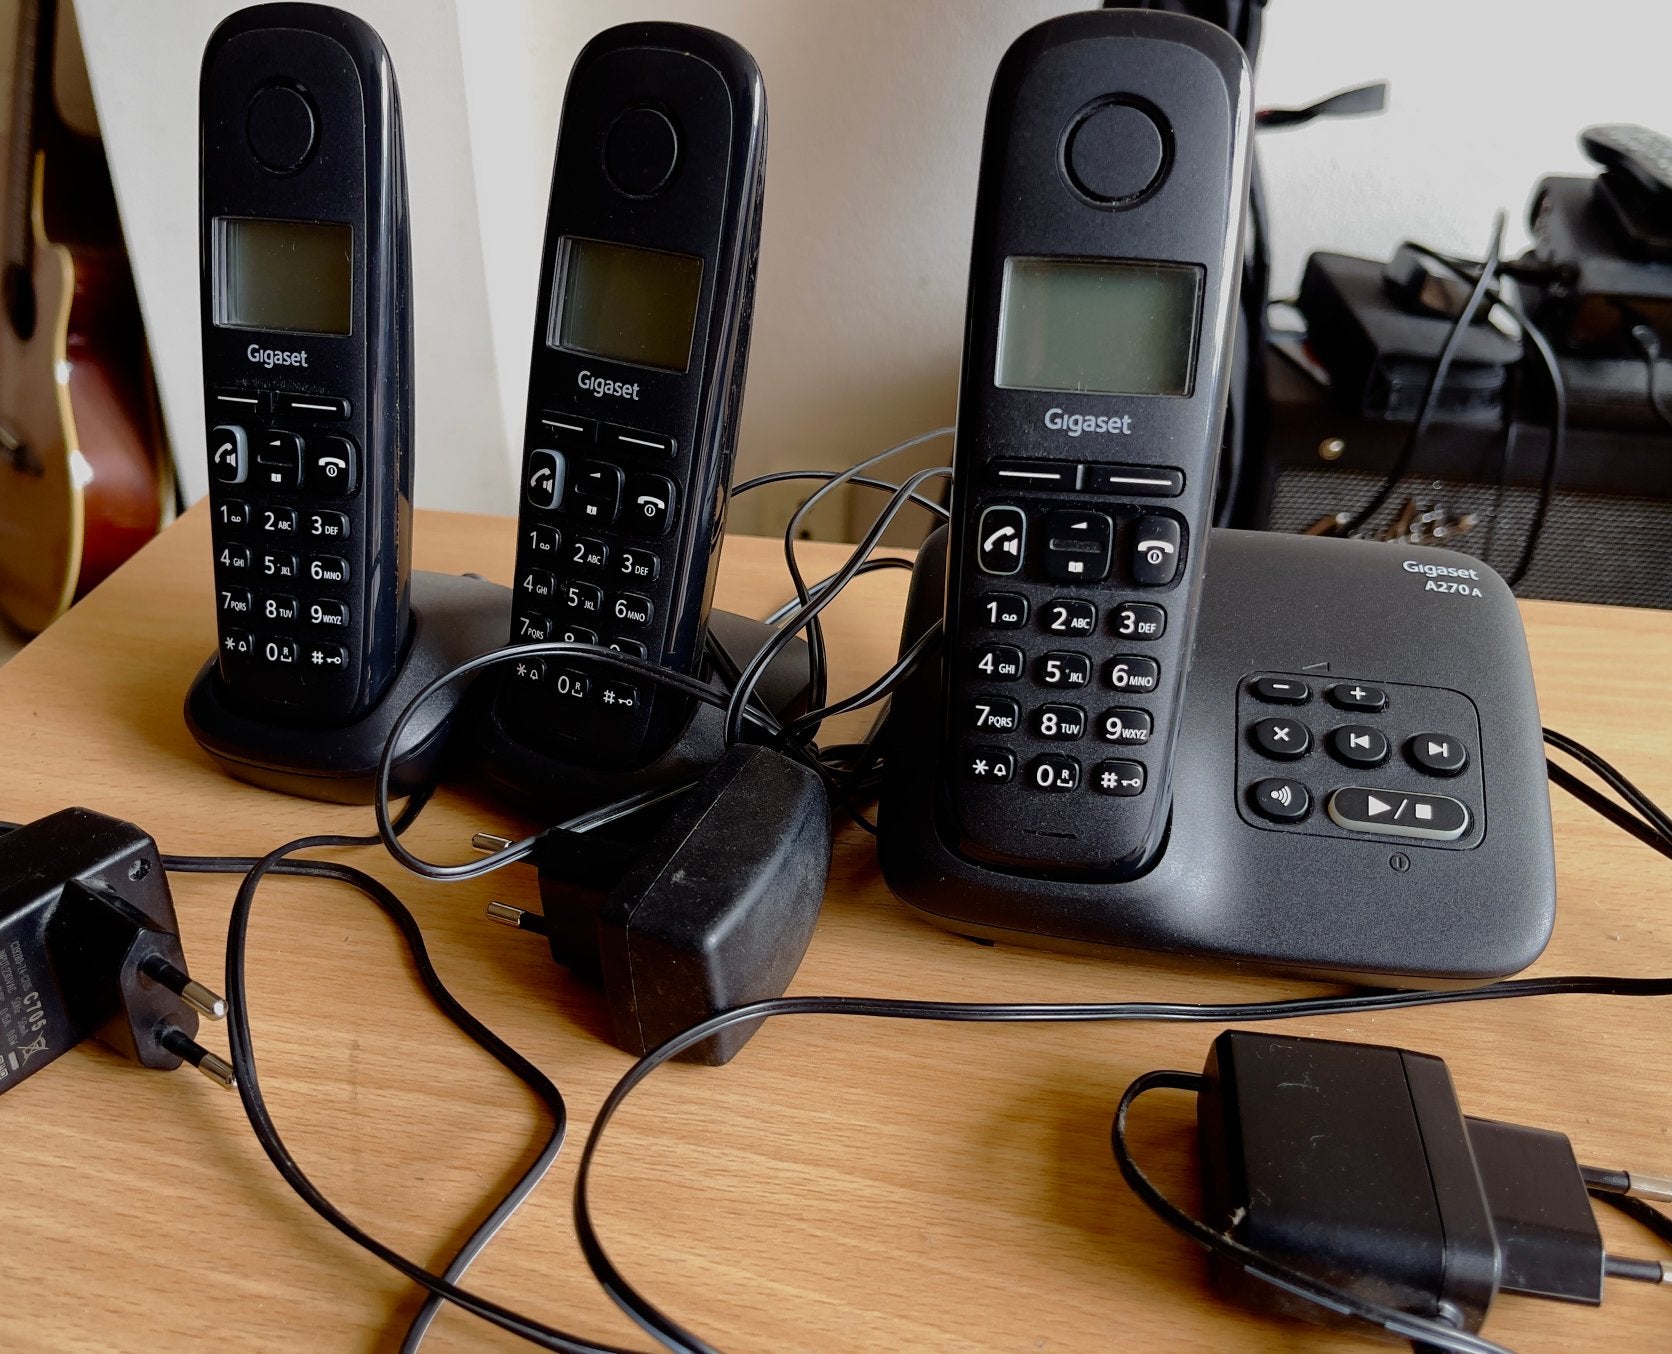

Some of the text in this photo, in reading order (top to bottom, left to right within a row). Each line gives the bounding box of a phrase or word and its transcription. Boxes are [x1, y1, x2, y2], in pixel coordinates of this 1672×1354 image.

[247, 344, 308, 368] Gigaset
[577, 370, 640, 400] Gigaset
[1044, 408, 1133, 437] Gigaset
[264, 512, 292, 531] 2 ABC
[311, 516, 339, 535] 3 DEF
[220, 549, 245, 567] 4 GHI
[573, 543, 601, 565] 2 ABC
[621, 554, 649, 576] 3 DEF
[264, 556, 275, 575] 5
[311, 561, 341, 580] 6 MNO
[1402, 560, 1480, 581] Gigaset
[523, 574, 548, 595] 4 GHI
[1425, 580, 1470, 596] A270
[222, 592, 232, 609] 7
[567, 588, 579, 607] 5
[266, 600, 293, 618] 8 TUV
[311, 606, 322, 624] 9
[615, 600, 646, 622] 6 MNO
[986, 601, 997, 623] 1
[1051, 607, 1091, 630] 2 ABC
[520, 617, 530, 635] 7
[1119, 611, 1157, 634] 3 DEF
[978, 653, 1015, 675] 4 GHI
[1045, 660, 1084, 683] 5 JKL
[1112, 664, 1153, 687] 6 MNO
[975, 705, 1013, 728] 7 PQRS
[1041, 713, 1080, 735] 8 TUV
[1106, 717, 1148, 740] 9 WXYZ
[1036, 765, 1054, 787] 0
[23, 992, 47, 1032] C705
